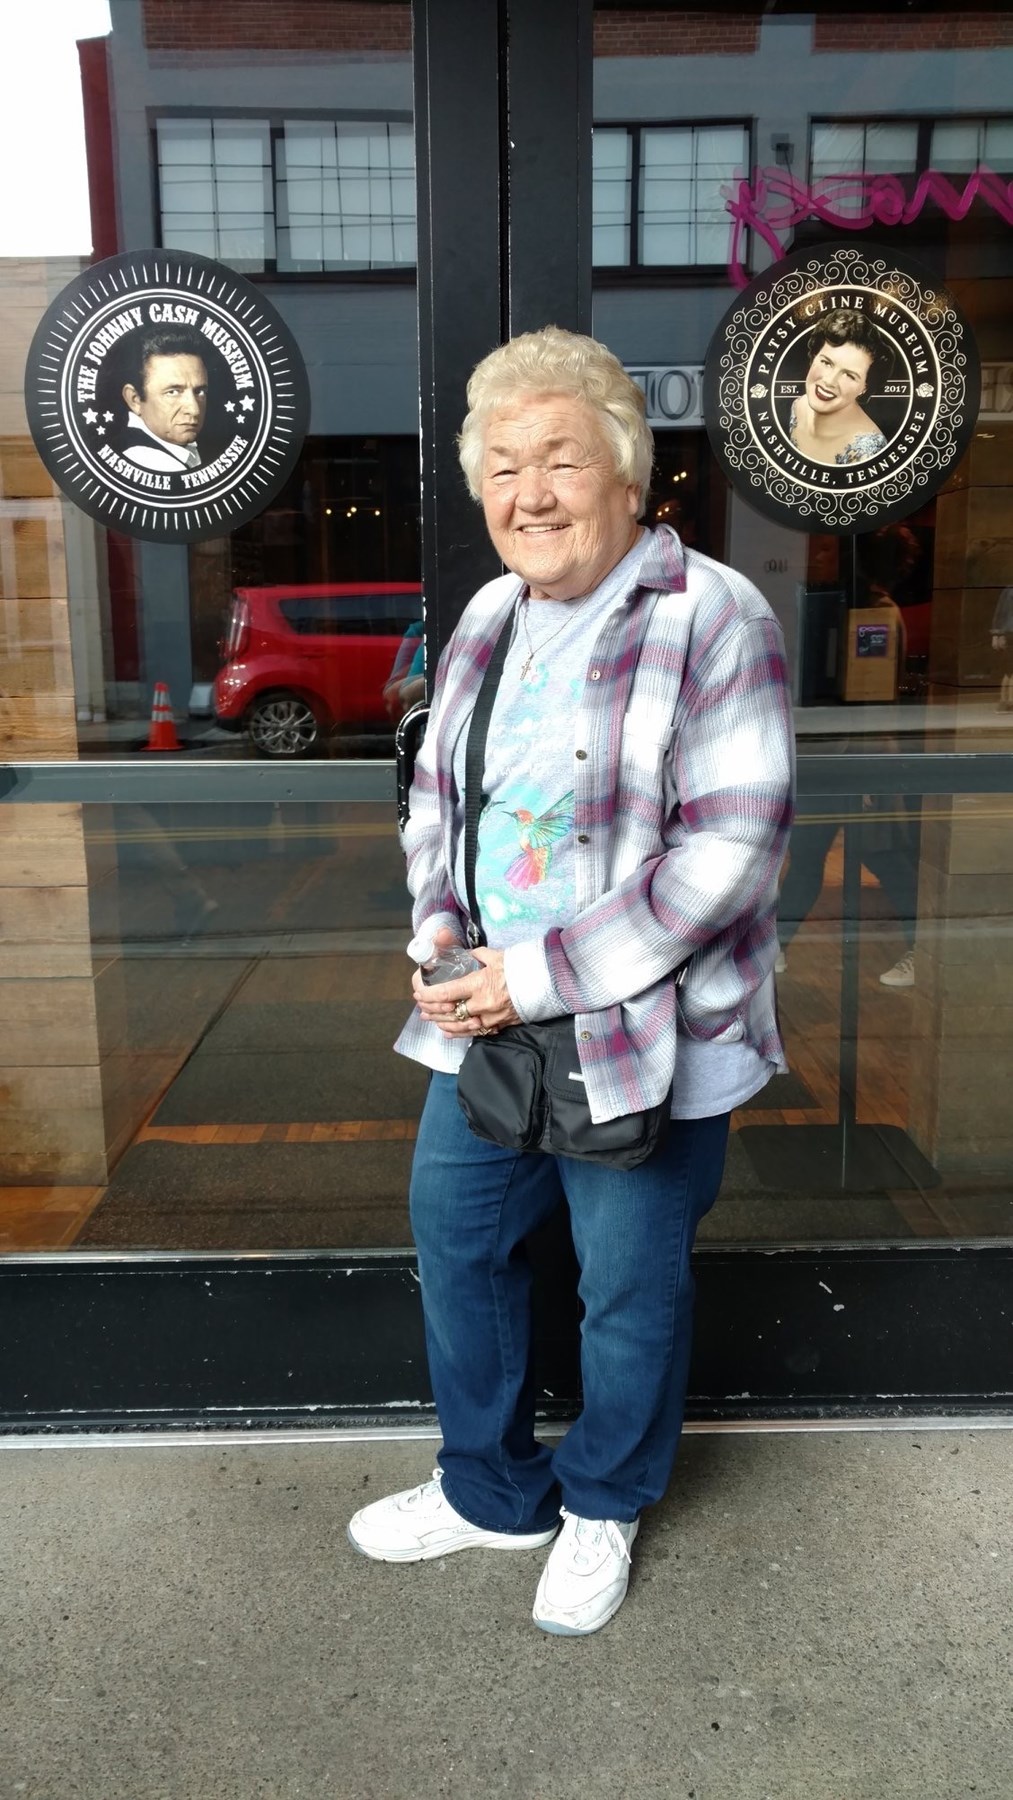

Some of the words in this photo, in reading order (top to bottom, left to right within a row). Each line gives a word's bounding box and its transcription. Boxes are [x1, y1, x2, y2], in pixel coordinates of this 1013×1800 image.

[84, 306, 143, 363] JOHNNY
[149, 303, 199, 326] CASH
[758, 317, 797, 375] PATSY
[804, 296, 865, 317] CLINE
[874, 304, 929, 375] MUSEUM
[200, 316, 255, 391] MUSEUM
[77, 365, 98, 403] THE
[780, 384, 800, 395] EST.
[884, 384, 908, 394] 2017
[97, 444, 171, 490] NASHVILLE
[181, 434, 249, 490] TENNESSEE
[758, 411, 837, 486] NASHVILLE,
[845, 411, 926, 485] TENNESSEE
